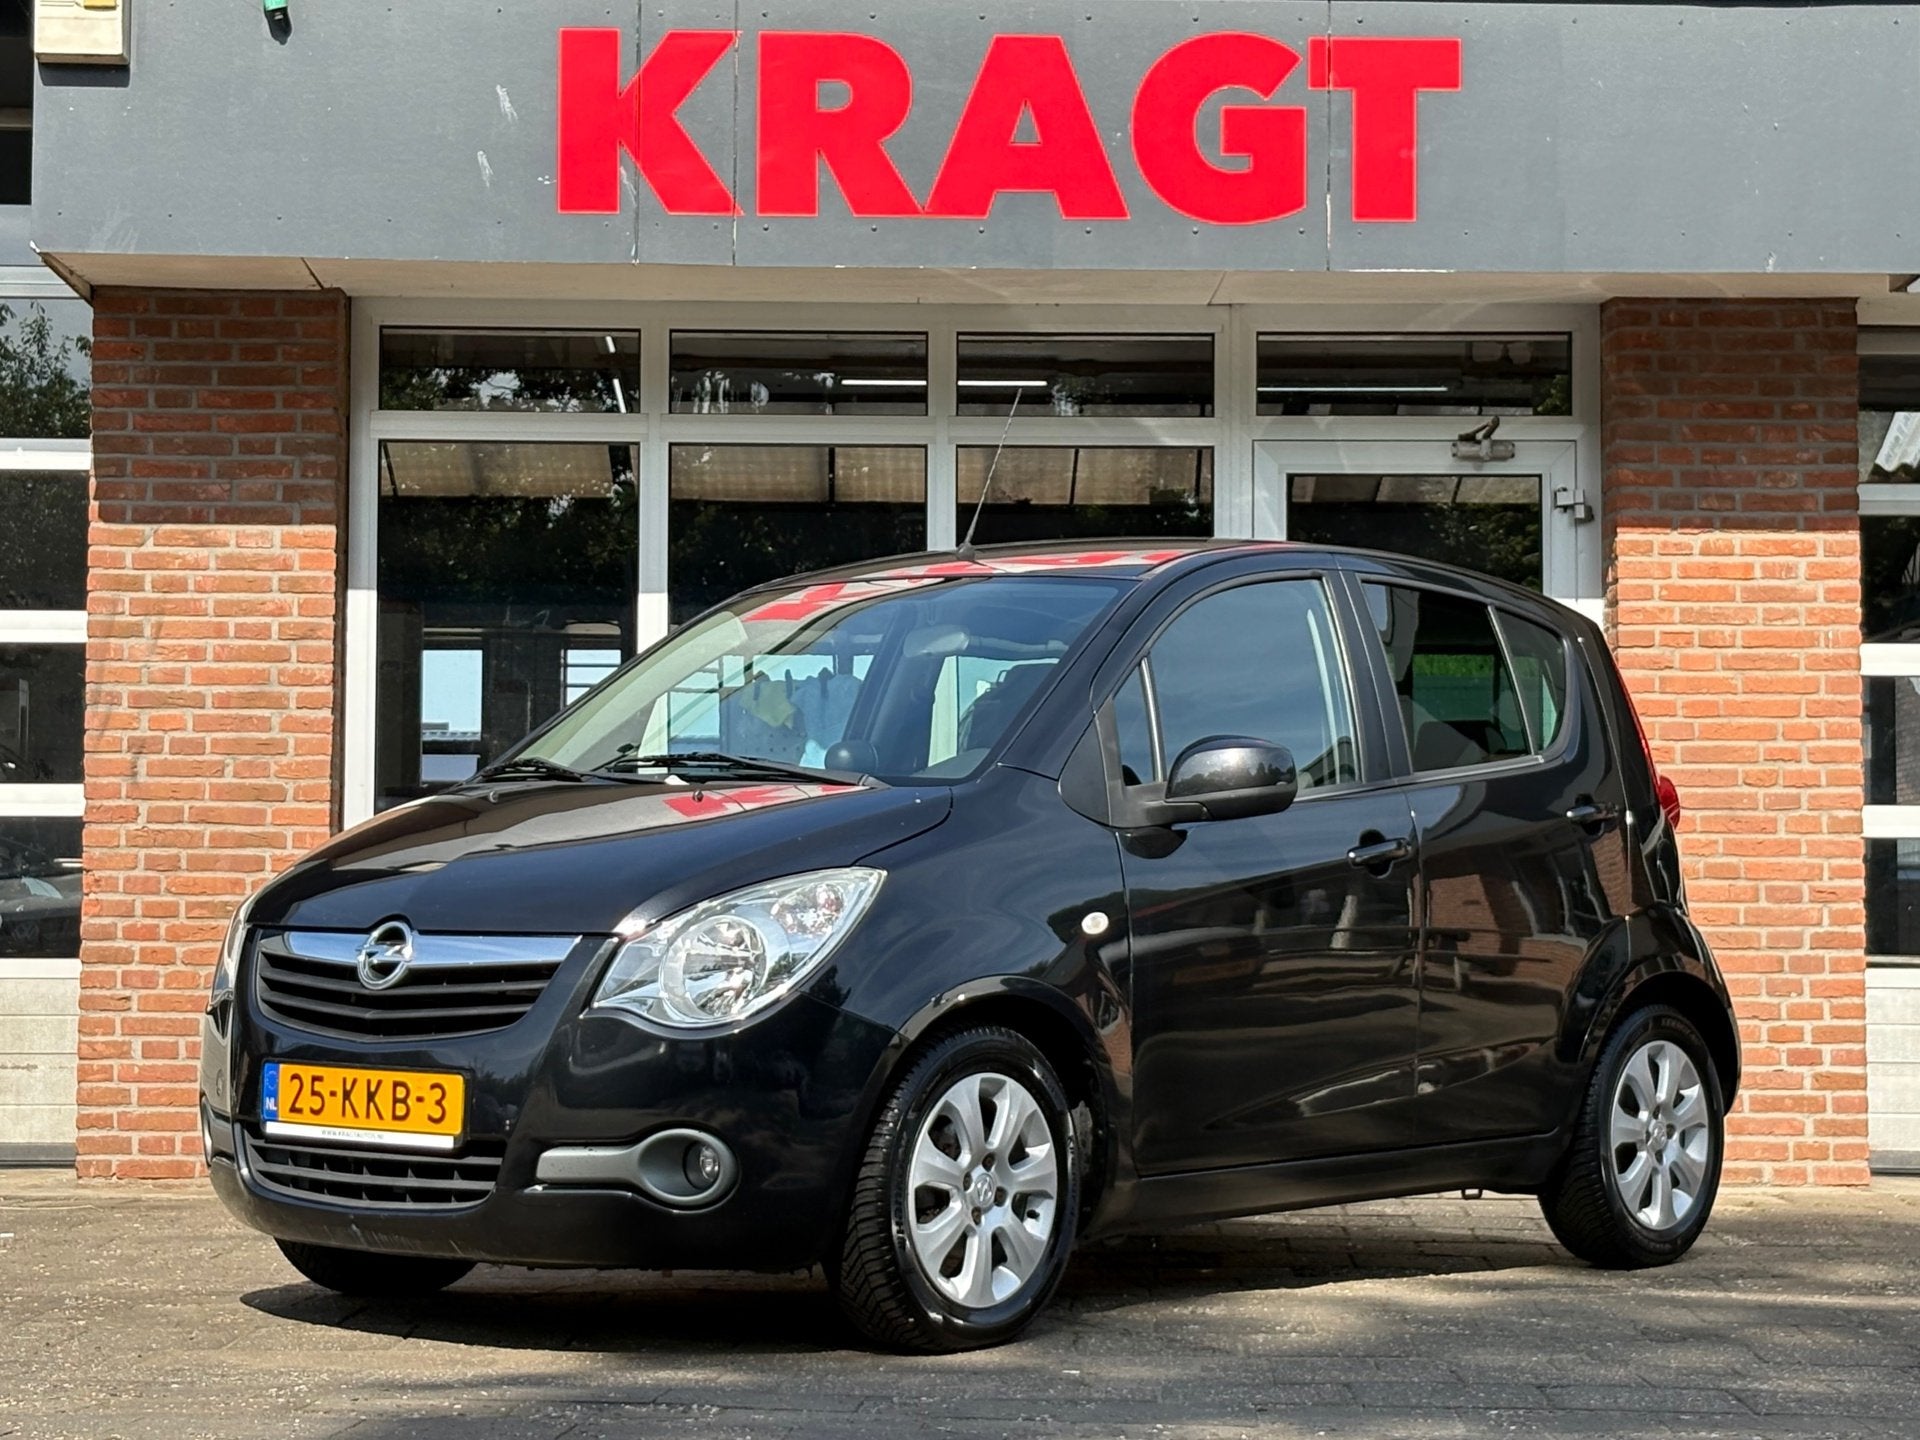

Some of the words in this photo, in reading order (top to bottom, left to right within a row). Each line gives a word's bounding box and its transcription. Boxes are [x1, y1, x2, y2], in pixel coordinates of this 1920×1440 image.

[557, 27, 1462, 225] KRAGT
[264, 1096, 278, 1111] NL
[288, 1073, 447, 1124] 25-KKB-3
